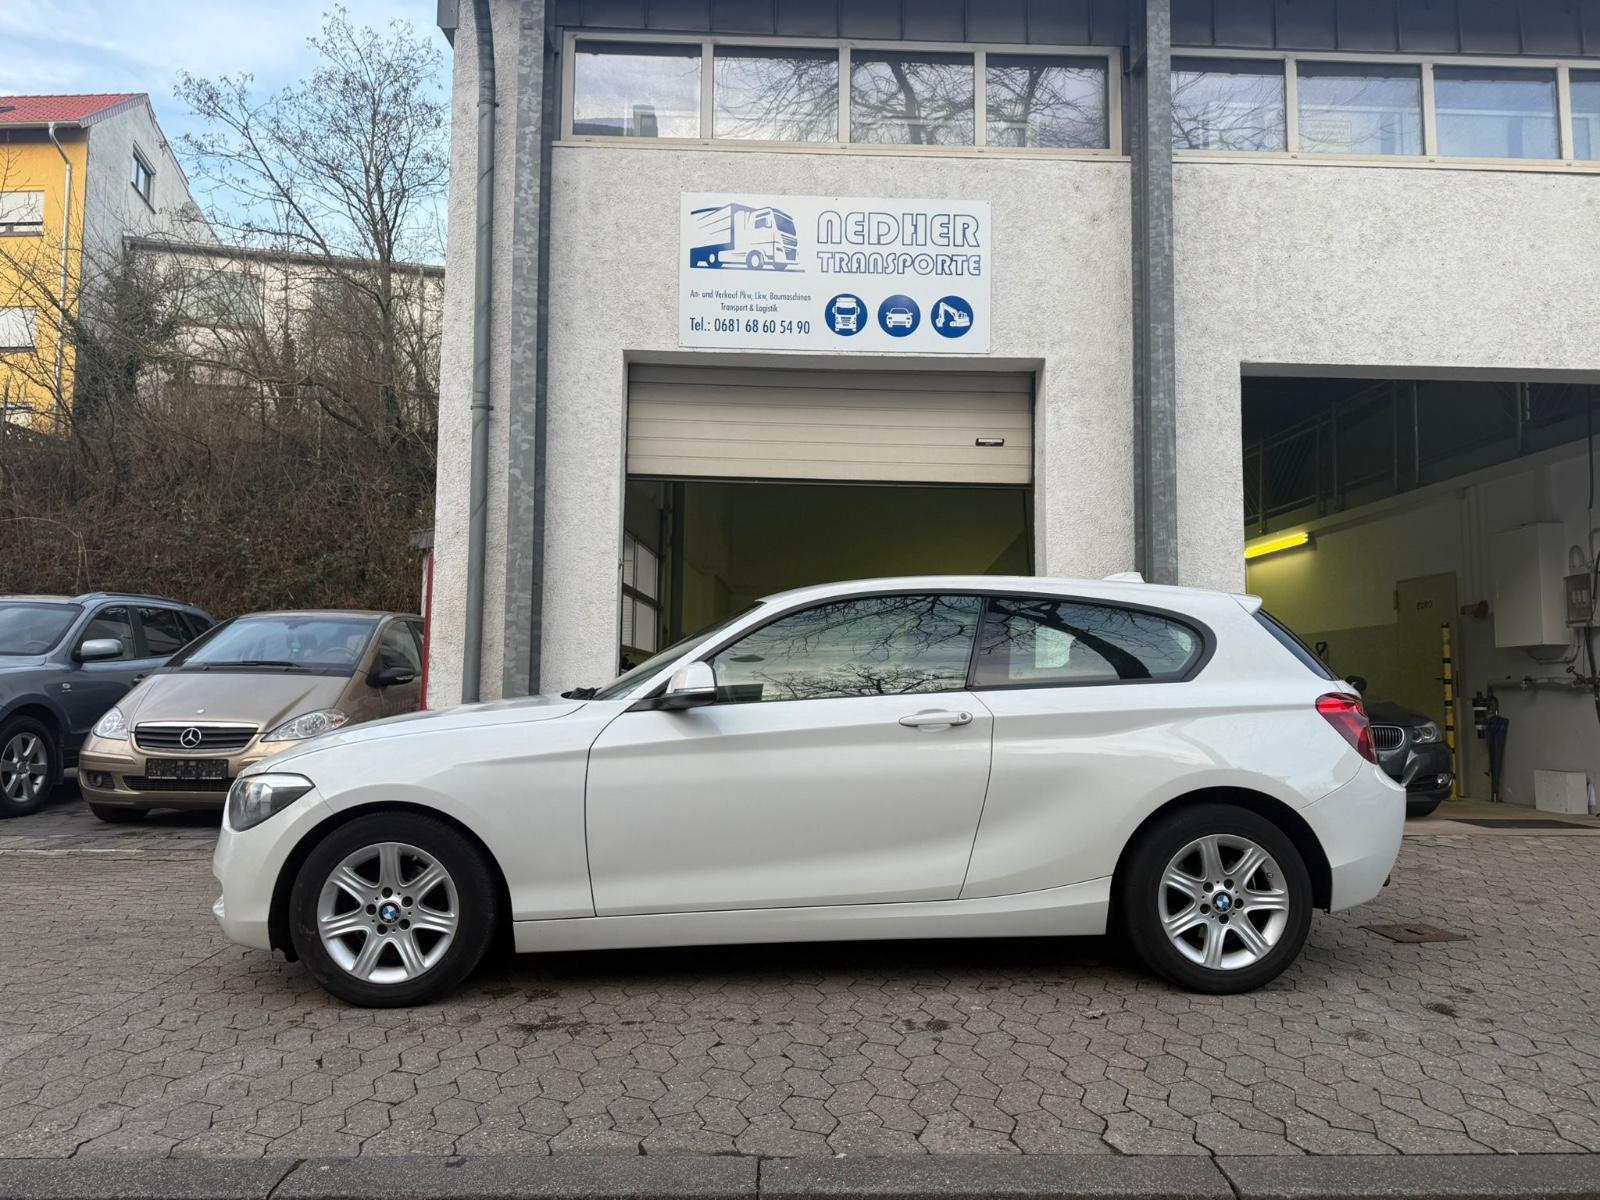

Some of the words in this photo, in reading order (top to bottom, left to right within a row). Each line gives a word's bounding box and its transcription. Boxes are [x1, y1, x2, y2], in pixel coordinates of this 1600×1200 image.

[817, 210, 980, 248] NEDHER
[816, 251, 981, 277] TRANSPORTE
[702, 290, 713, 299] und
[715, 290, 738, 300] Verkauf
[769, 291, 811, 302] Baumaschinen
[720, 302, 748, 313] Transport
[749, 304, 754, 312] &
[756, 303, 778, 314] Logistik
[689, 316, 711, 332] Tel.:
[714, 318, 740, 333] 0681
[745, 319, 759, 334] 68
[762, 319, 776, 334] 60
[779, 320, 793, 335] 54
[796, 320, 810, 336] 90
